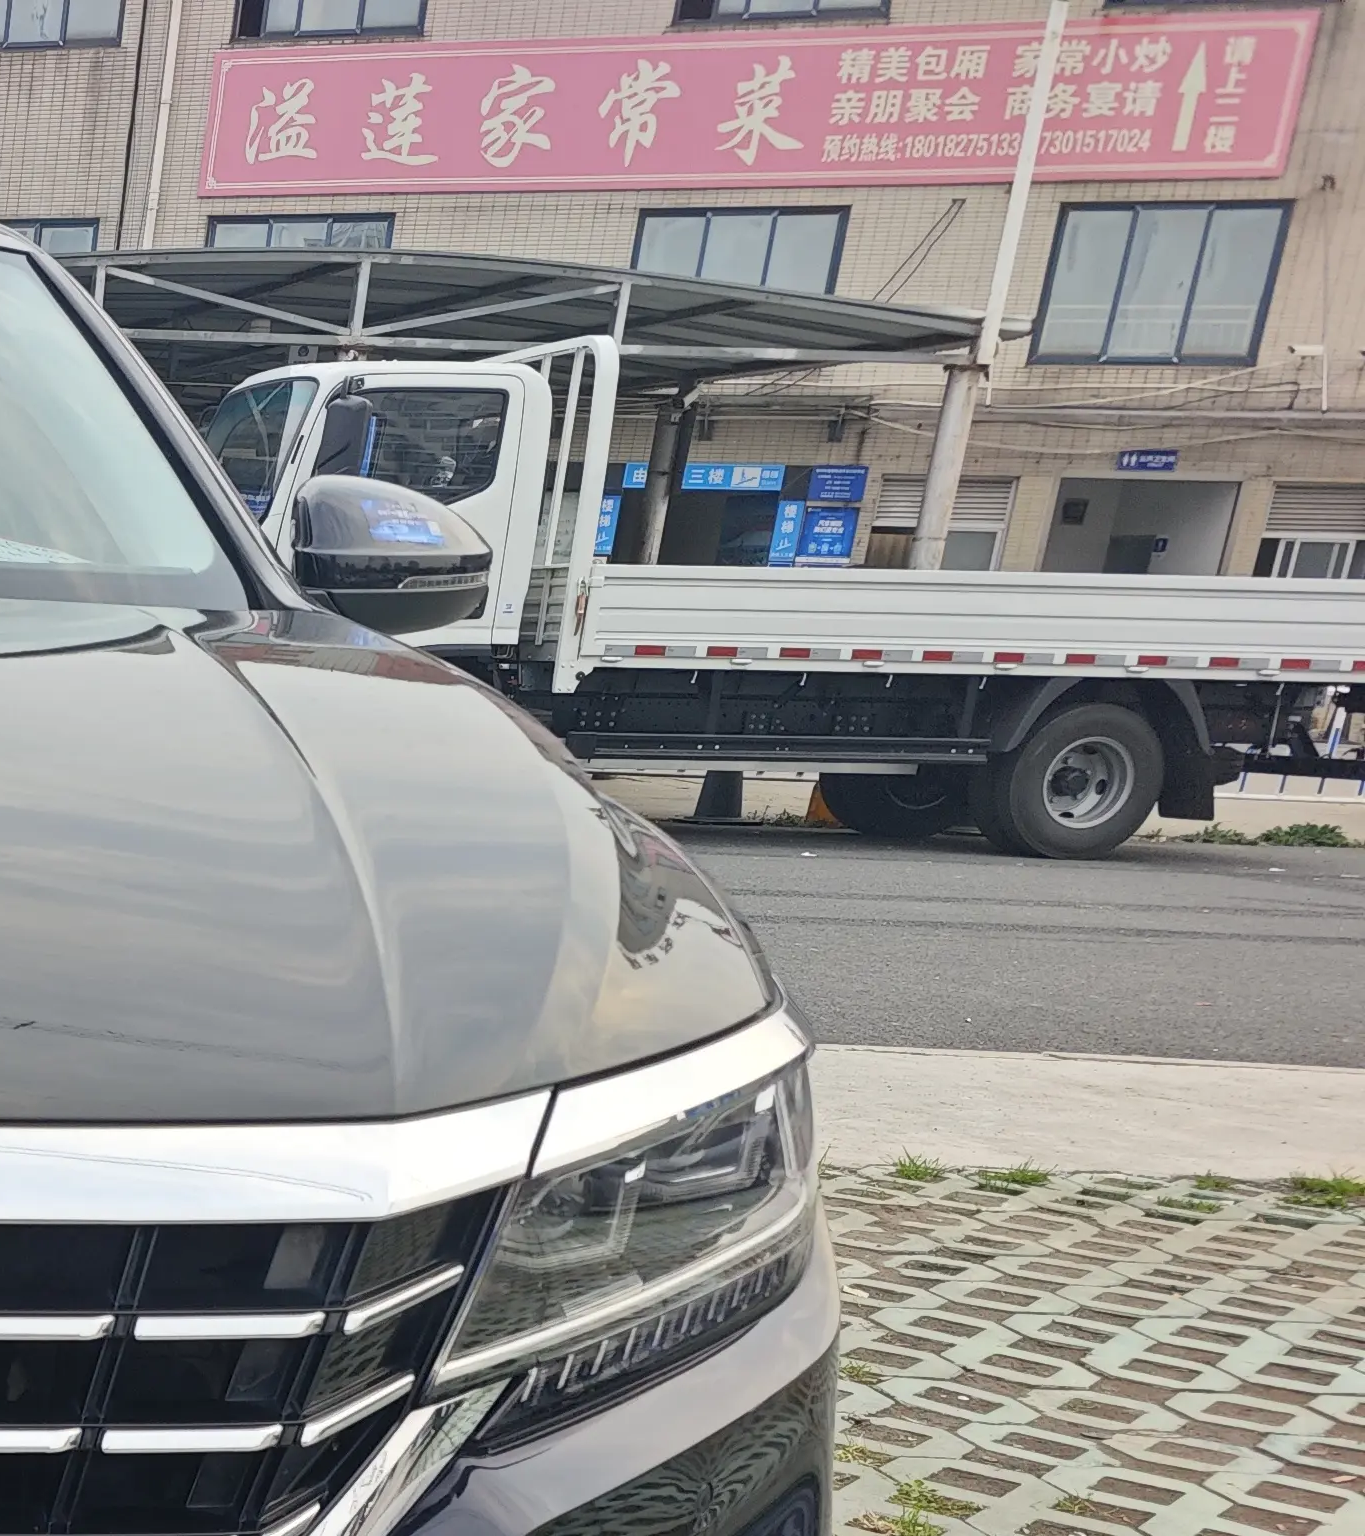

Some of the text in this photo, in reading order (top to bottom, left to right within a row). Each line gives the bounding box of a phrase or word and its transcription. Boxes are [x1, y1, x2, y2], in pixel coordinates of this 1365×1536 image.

[836, 44, 991, 85] 精美包厢
[828, 86, 982, 126] 亲朋聚会
[1204, 36, 1255, 154] 请上二楼
